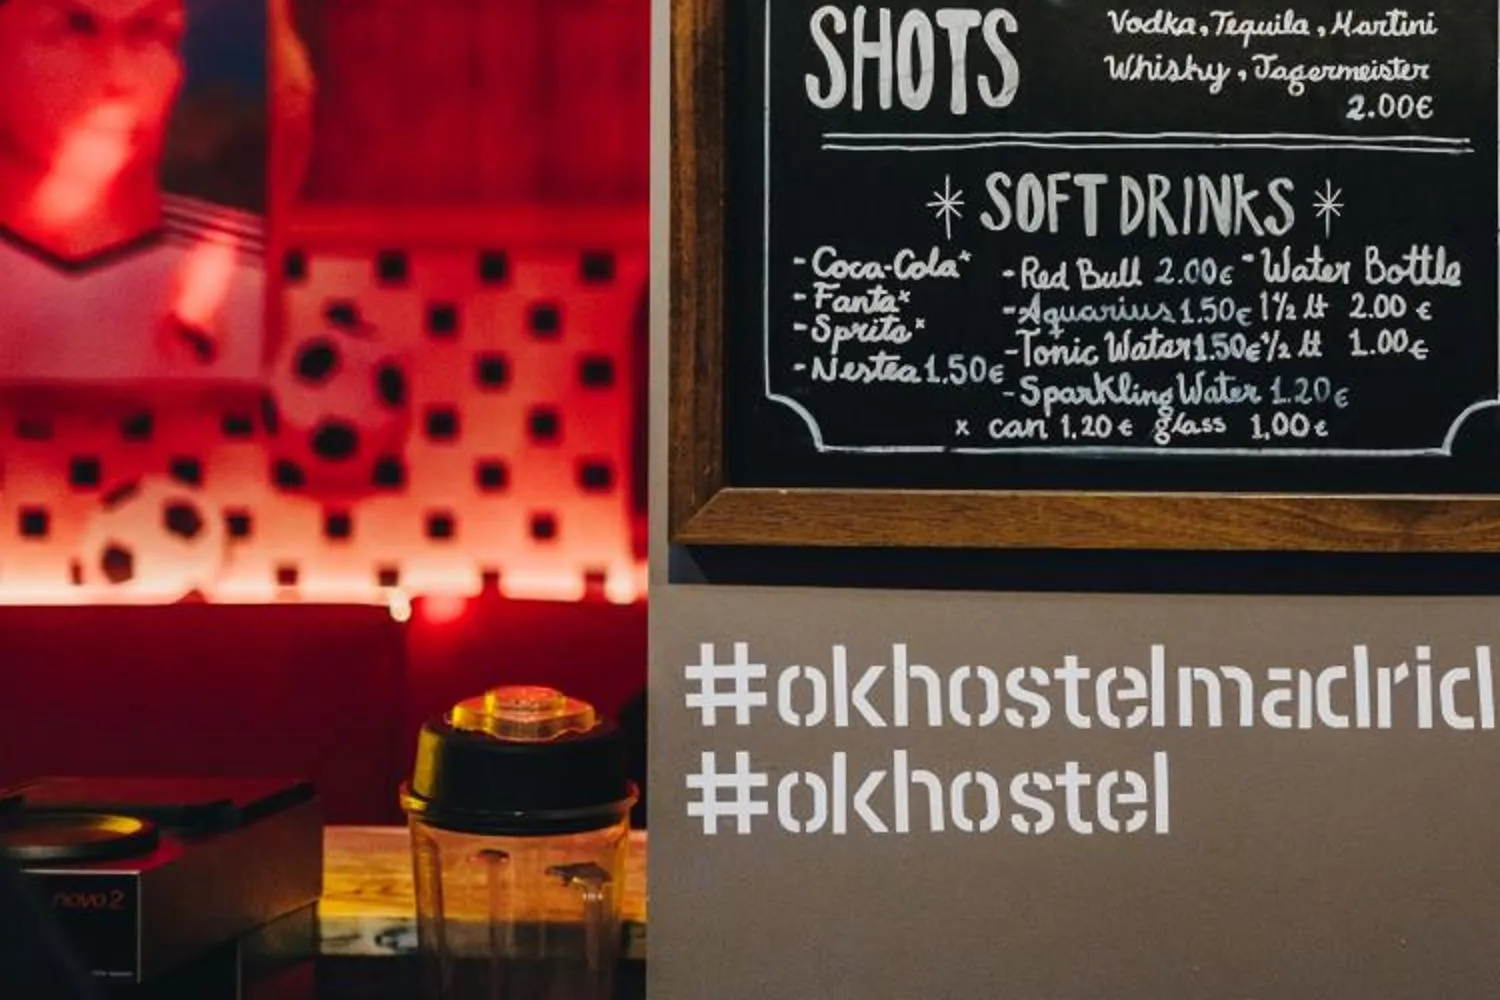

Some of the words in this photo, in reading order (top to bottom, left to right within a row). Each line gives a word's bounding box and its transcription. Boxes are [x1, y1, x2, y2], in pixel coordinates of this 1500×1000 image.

[1331, 8, 1439, 37] Martini
[805, 5, 1020, 115] SHOTS
[1252, 53, 1430, 96] Jagermeister
[1346, 94, 1433, 121] 2.00€
[980, 171, 1108, 236] SOFT
[1021, 256, 1070, 291] Red
[1076, 256, 1142, 290] Bull
[1154, 257, 1234, 286] 2.00€
[1261, 245, 1351, 285] Water
[1365, 244, 1462, 287] Bottle
[1018, 292, 1176, 339] Aquarius
[1180, 296, 1252, 326] 1.50€
[1016, 328, 1098, 367] Tonic
[1104, 327, 1191, 363] Water
[1193, 333, 1261, 362] 1.50€
[1348, 327, 1429, 361] 1.00€
[811, 351, 921, 384] Nestea
[1176, 371, 1262, 404] Water
[1270, 376, 1349, 409] 1.20€
[989, 417, 1048, 440] can
[1154, 411, 1227, 446] glass
[685, 642, 1495, 730] #okhostelmadrid
[686, 750, 1169, 835] #okhostel
